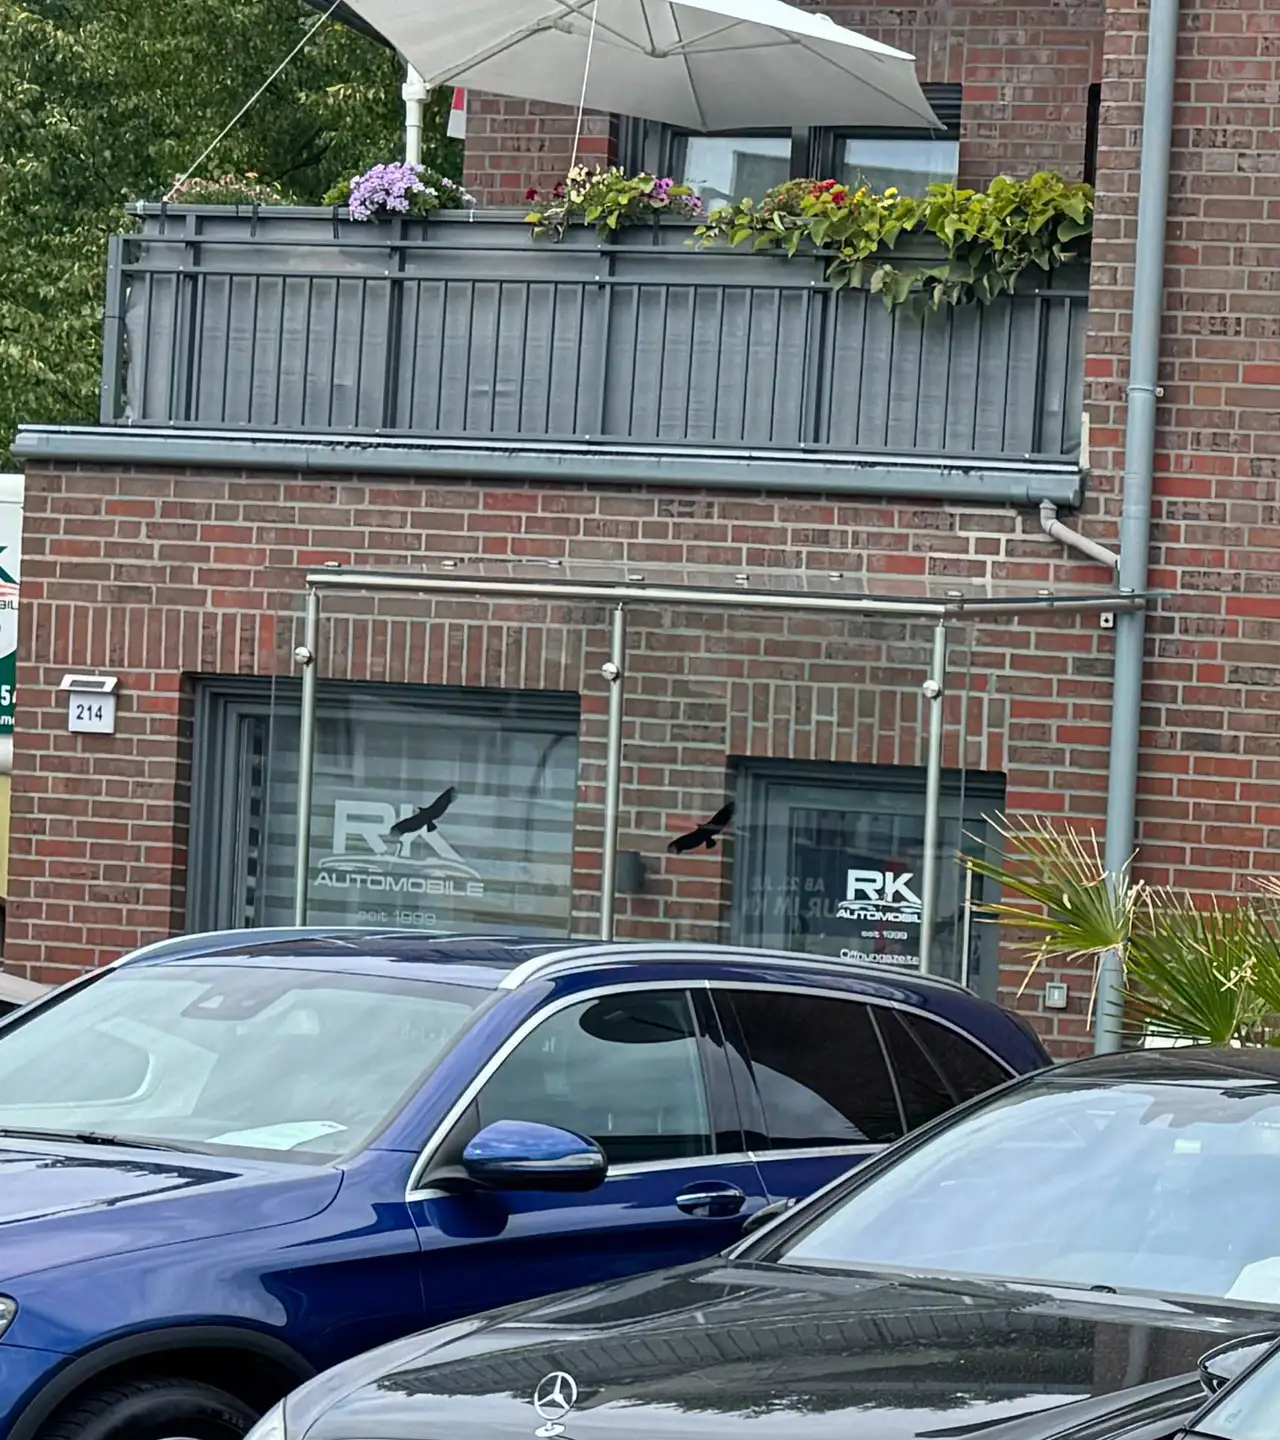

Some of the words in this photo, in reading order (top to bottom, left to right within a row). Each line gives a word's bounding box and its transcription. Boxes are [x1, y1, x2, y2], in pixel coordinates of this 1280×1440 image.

[76, 704, 103, 721] 214
[313, 871, 485, 898] AUTOMOBILE
[846, 869, 921, 903] RK
[392, 910, 437, 925] 1999
[836, 909, 922, 923] AUTOMOBIL
